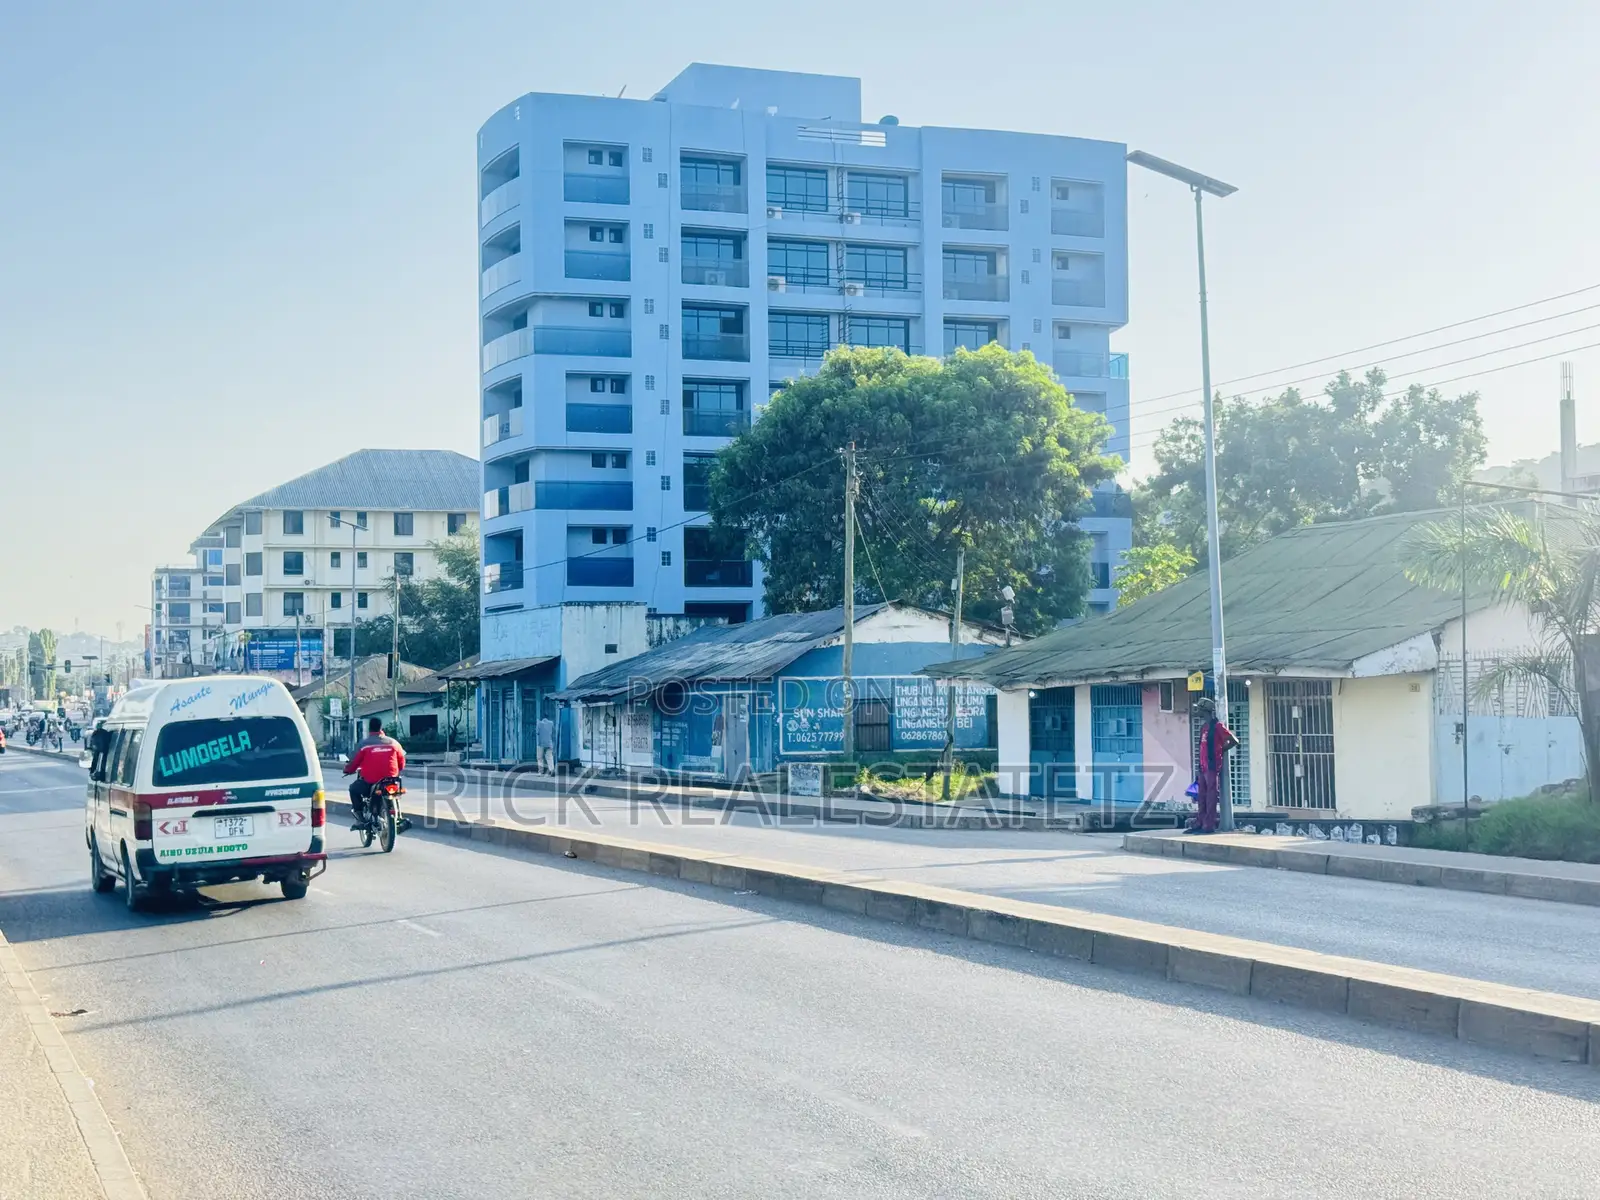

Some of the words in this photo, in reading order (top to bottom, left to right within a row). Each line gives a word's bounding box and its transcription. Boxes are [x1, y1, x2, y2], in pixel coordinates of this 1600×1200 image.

[170, 686, 212, 716] Asante
[229, 681, 275, 710] Mungu
[956, 718, 973, 728] BEI
[901, 731, 948, 741] 062867867
[160, 730, 252, 777] LUMOGELA
